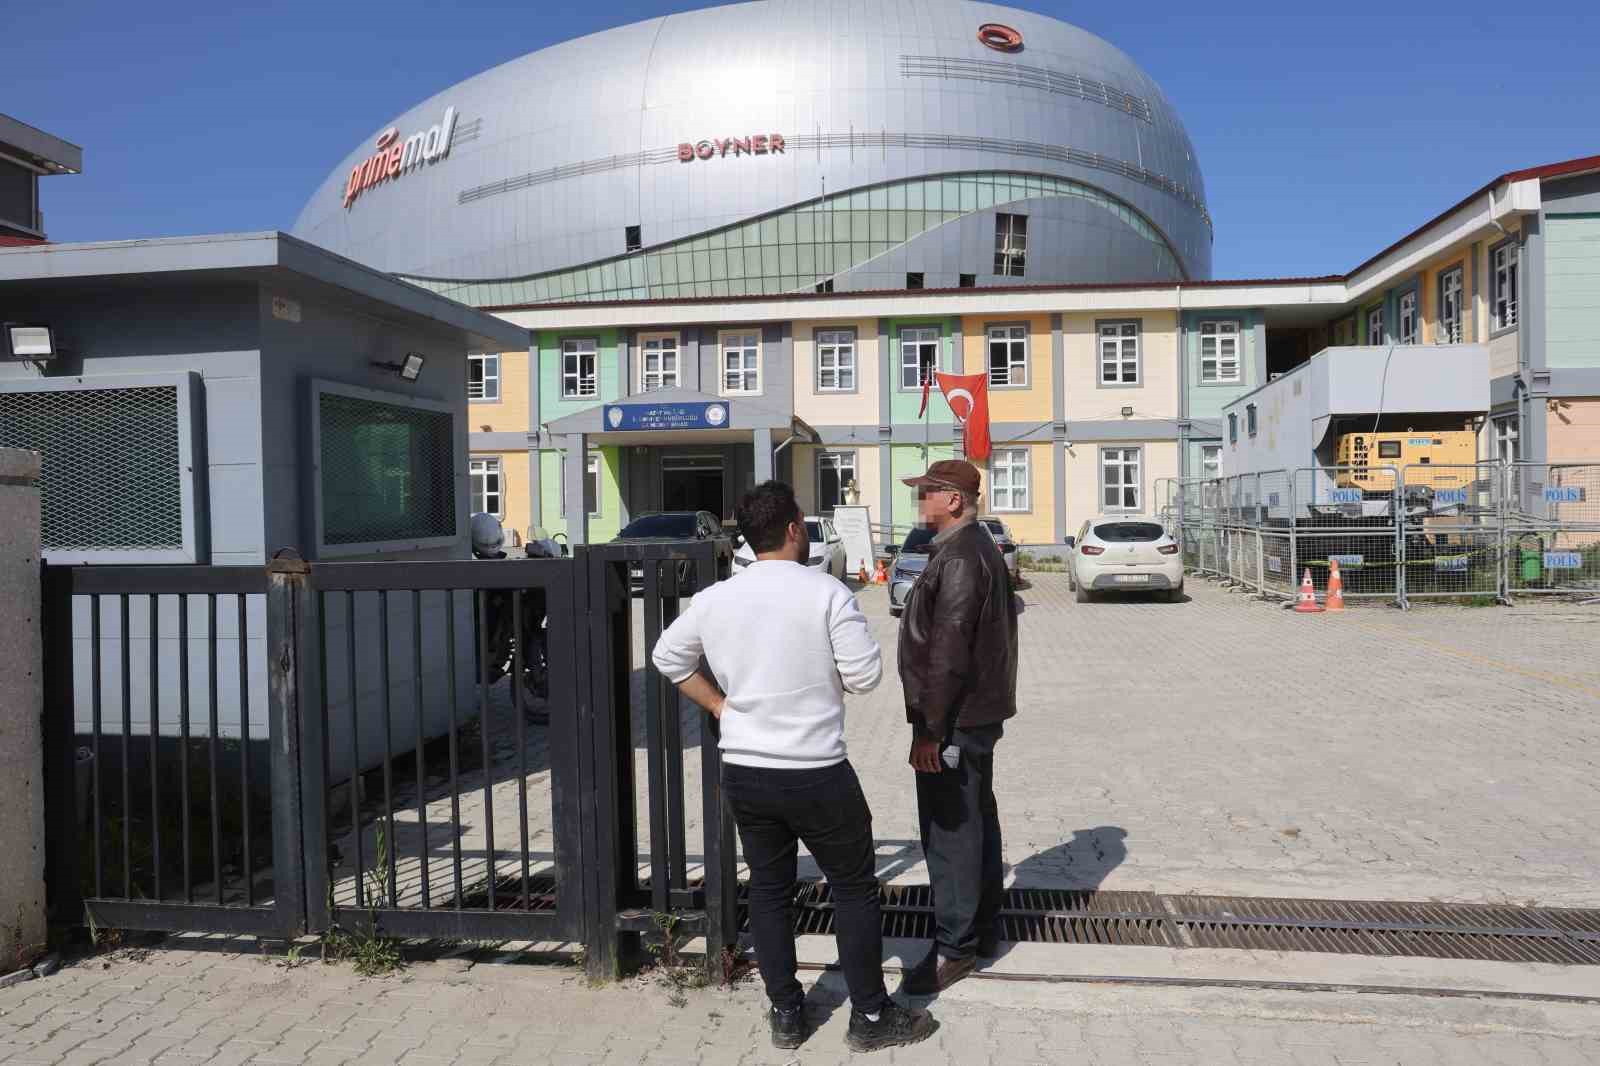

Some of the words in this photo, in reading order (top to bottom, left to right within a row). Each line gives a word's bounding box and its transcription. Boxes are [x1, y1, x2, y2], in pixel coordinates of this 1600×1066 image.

[678, 134, 785, 162] BOYNER
[1545, 488, 1577, 501] POLİS
[1547, 552, 1578, 566] POLİS
